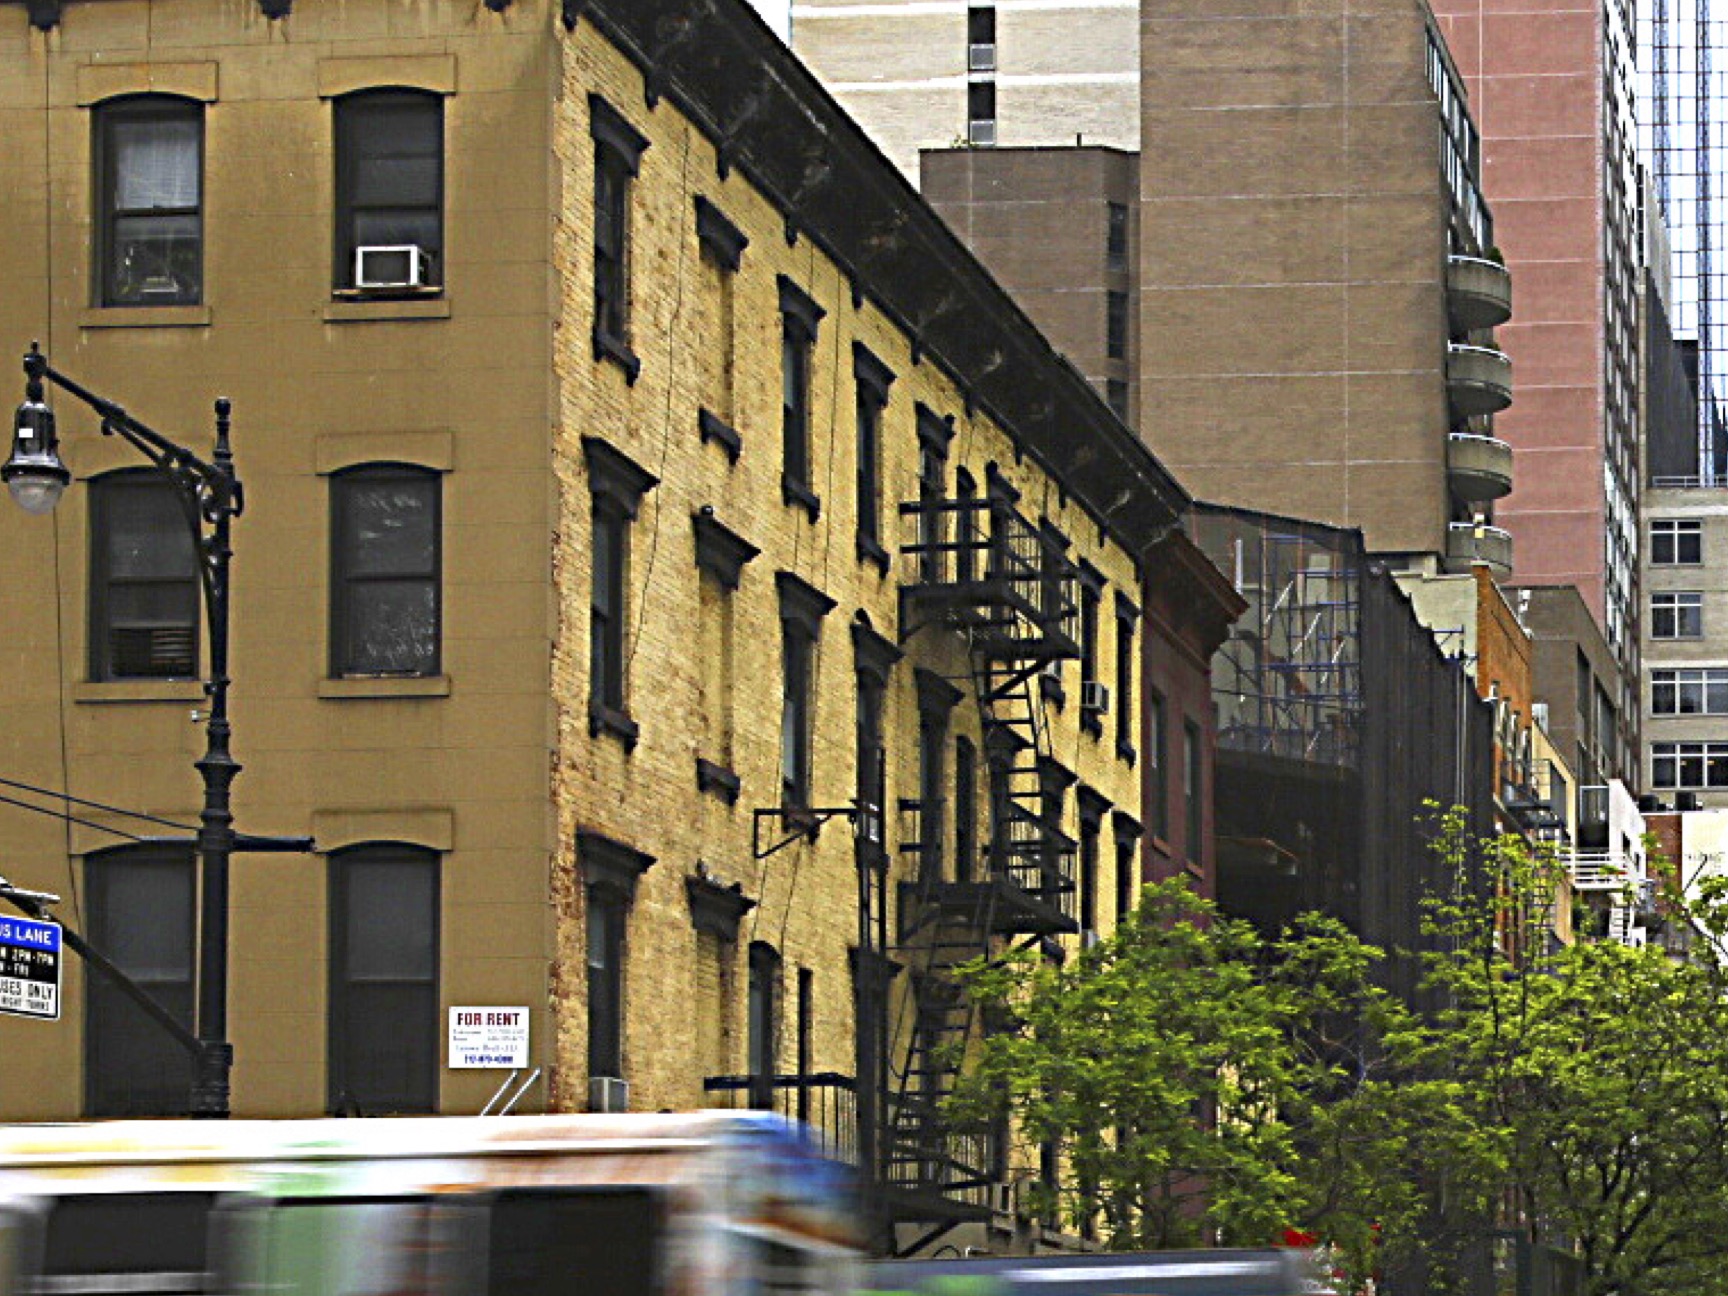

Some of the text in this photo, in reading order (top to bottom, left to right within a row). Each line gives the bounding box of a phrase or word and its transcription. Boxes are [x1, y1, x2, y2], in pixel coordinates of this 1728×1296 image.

[16, 926, 52, 946] LANE
[28, 983, 54, 1001] ONLY
[457, 1012, 520, 1026] FOR RENT
